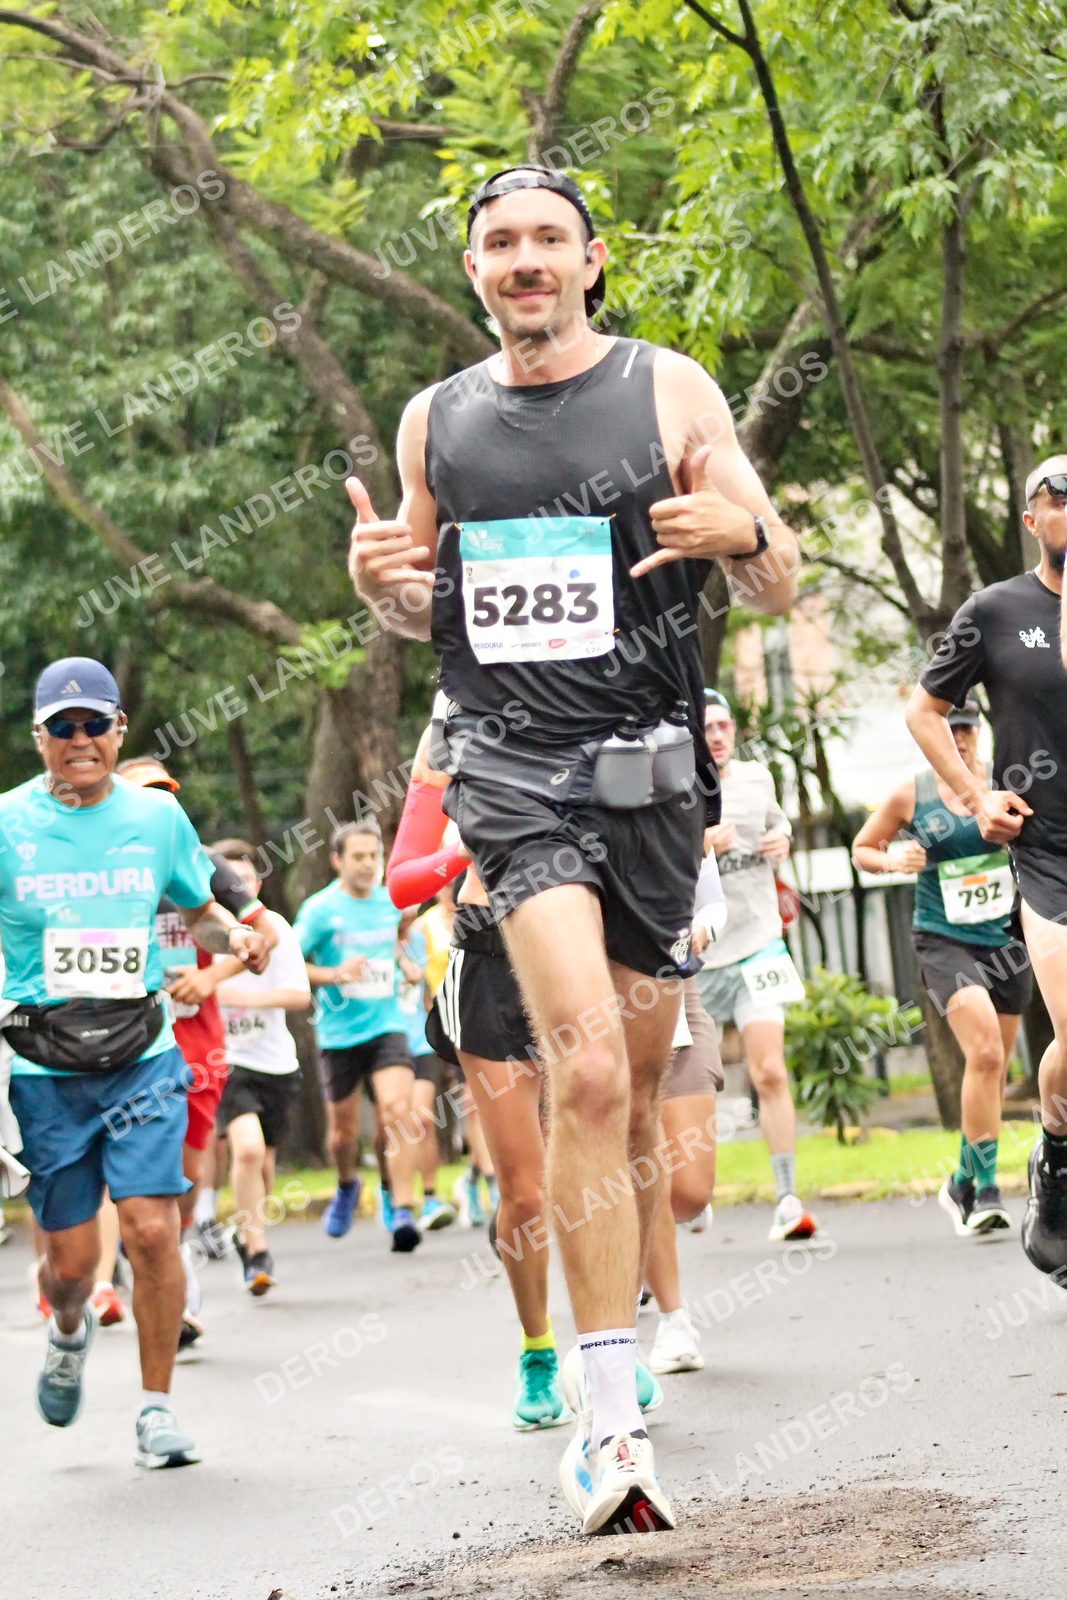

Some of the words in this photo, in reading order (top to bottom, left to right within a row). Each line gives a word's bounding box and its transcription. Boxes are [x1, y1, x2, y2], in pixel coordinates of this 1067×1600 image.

[473, 583, 598, 627] 5283
[16, 867, 155, 901] PERDURA
[958, 882, 1003, 907] 792
[53, 947, 141, 974] 3058
[752, 970, 788, 991] 39
